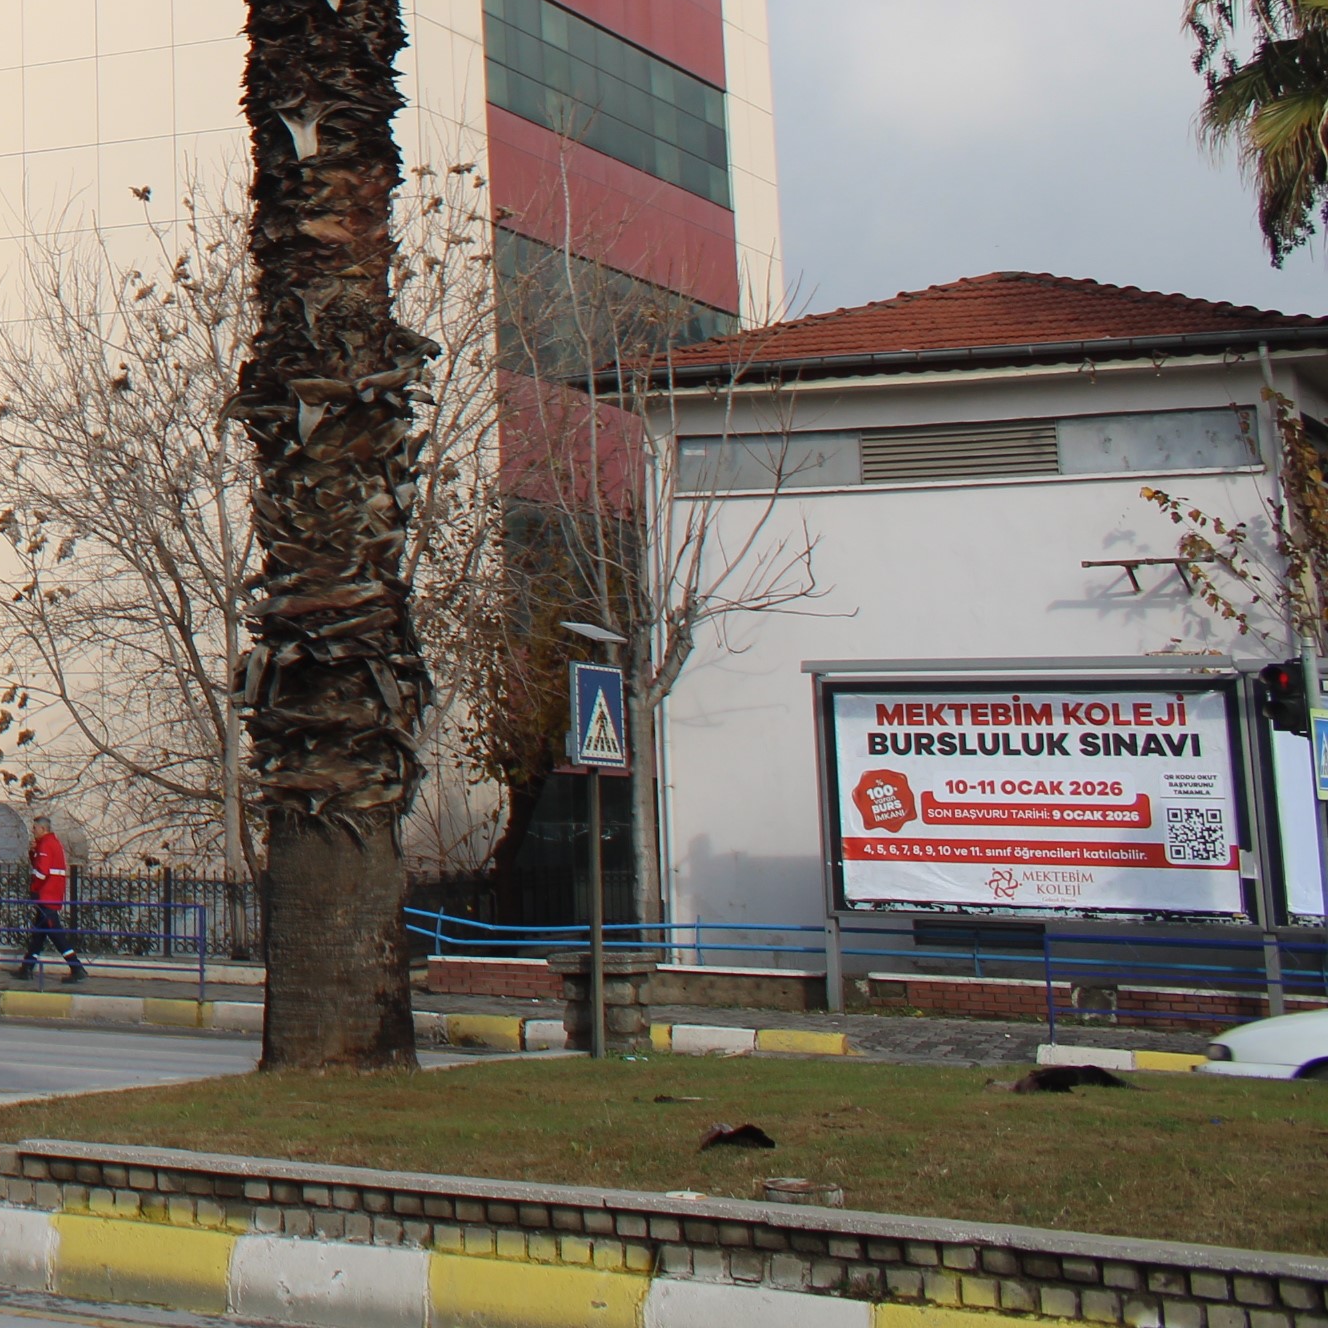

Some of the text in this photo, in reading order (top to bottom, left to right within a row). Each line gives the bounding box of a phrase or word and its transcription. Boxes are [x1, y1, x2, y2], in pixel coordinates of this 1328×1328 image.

[875, 693, 1188, 726] MEKTEBİM KOLEJİ
[867, 732, 1202, 757] BURSLULUK SINAVI
[945, 779, 1123, 796] 10-11 OCAK 2026
[871, 799, 902, 814] BURS
[874, 795, 896, 805] varan
[874, 809, 905, 822] İMKANI
[927, 807, 1139, 821] SON BAŞVURU TARİHİ: 9 OCAK 2026
[863, 844, 1148, 860] 4, 5, 6, 7, 8, 9, 10 ve 11. sınıf öğrencileri katılabilir.
[1022, 869, 1094, 883] MEKTEBİM
[1036, 883, 1082, 897] KOLEJİ
